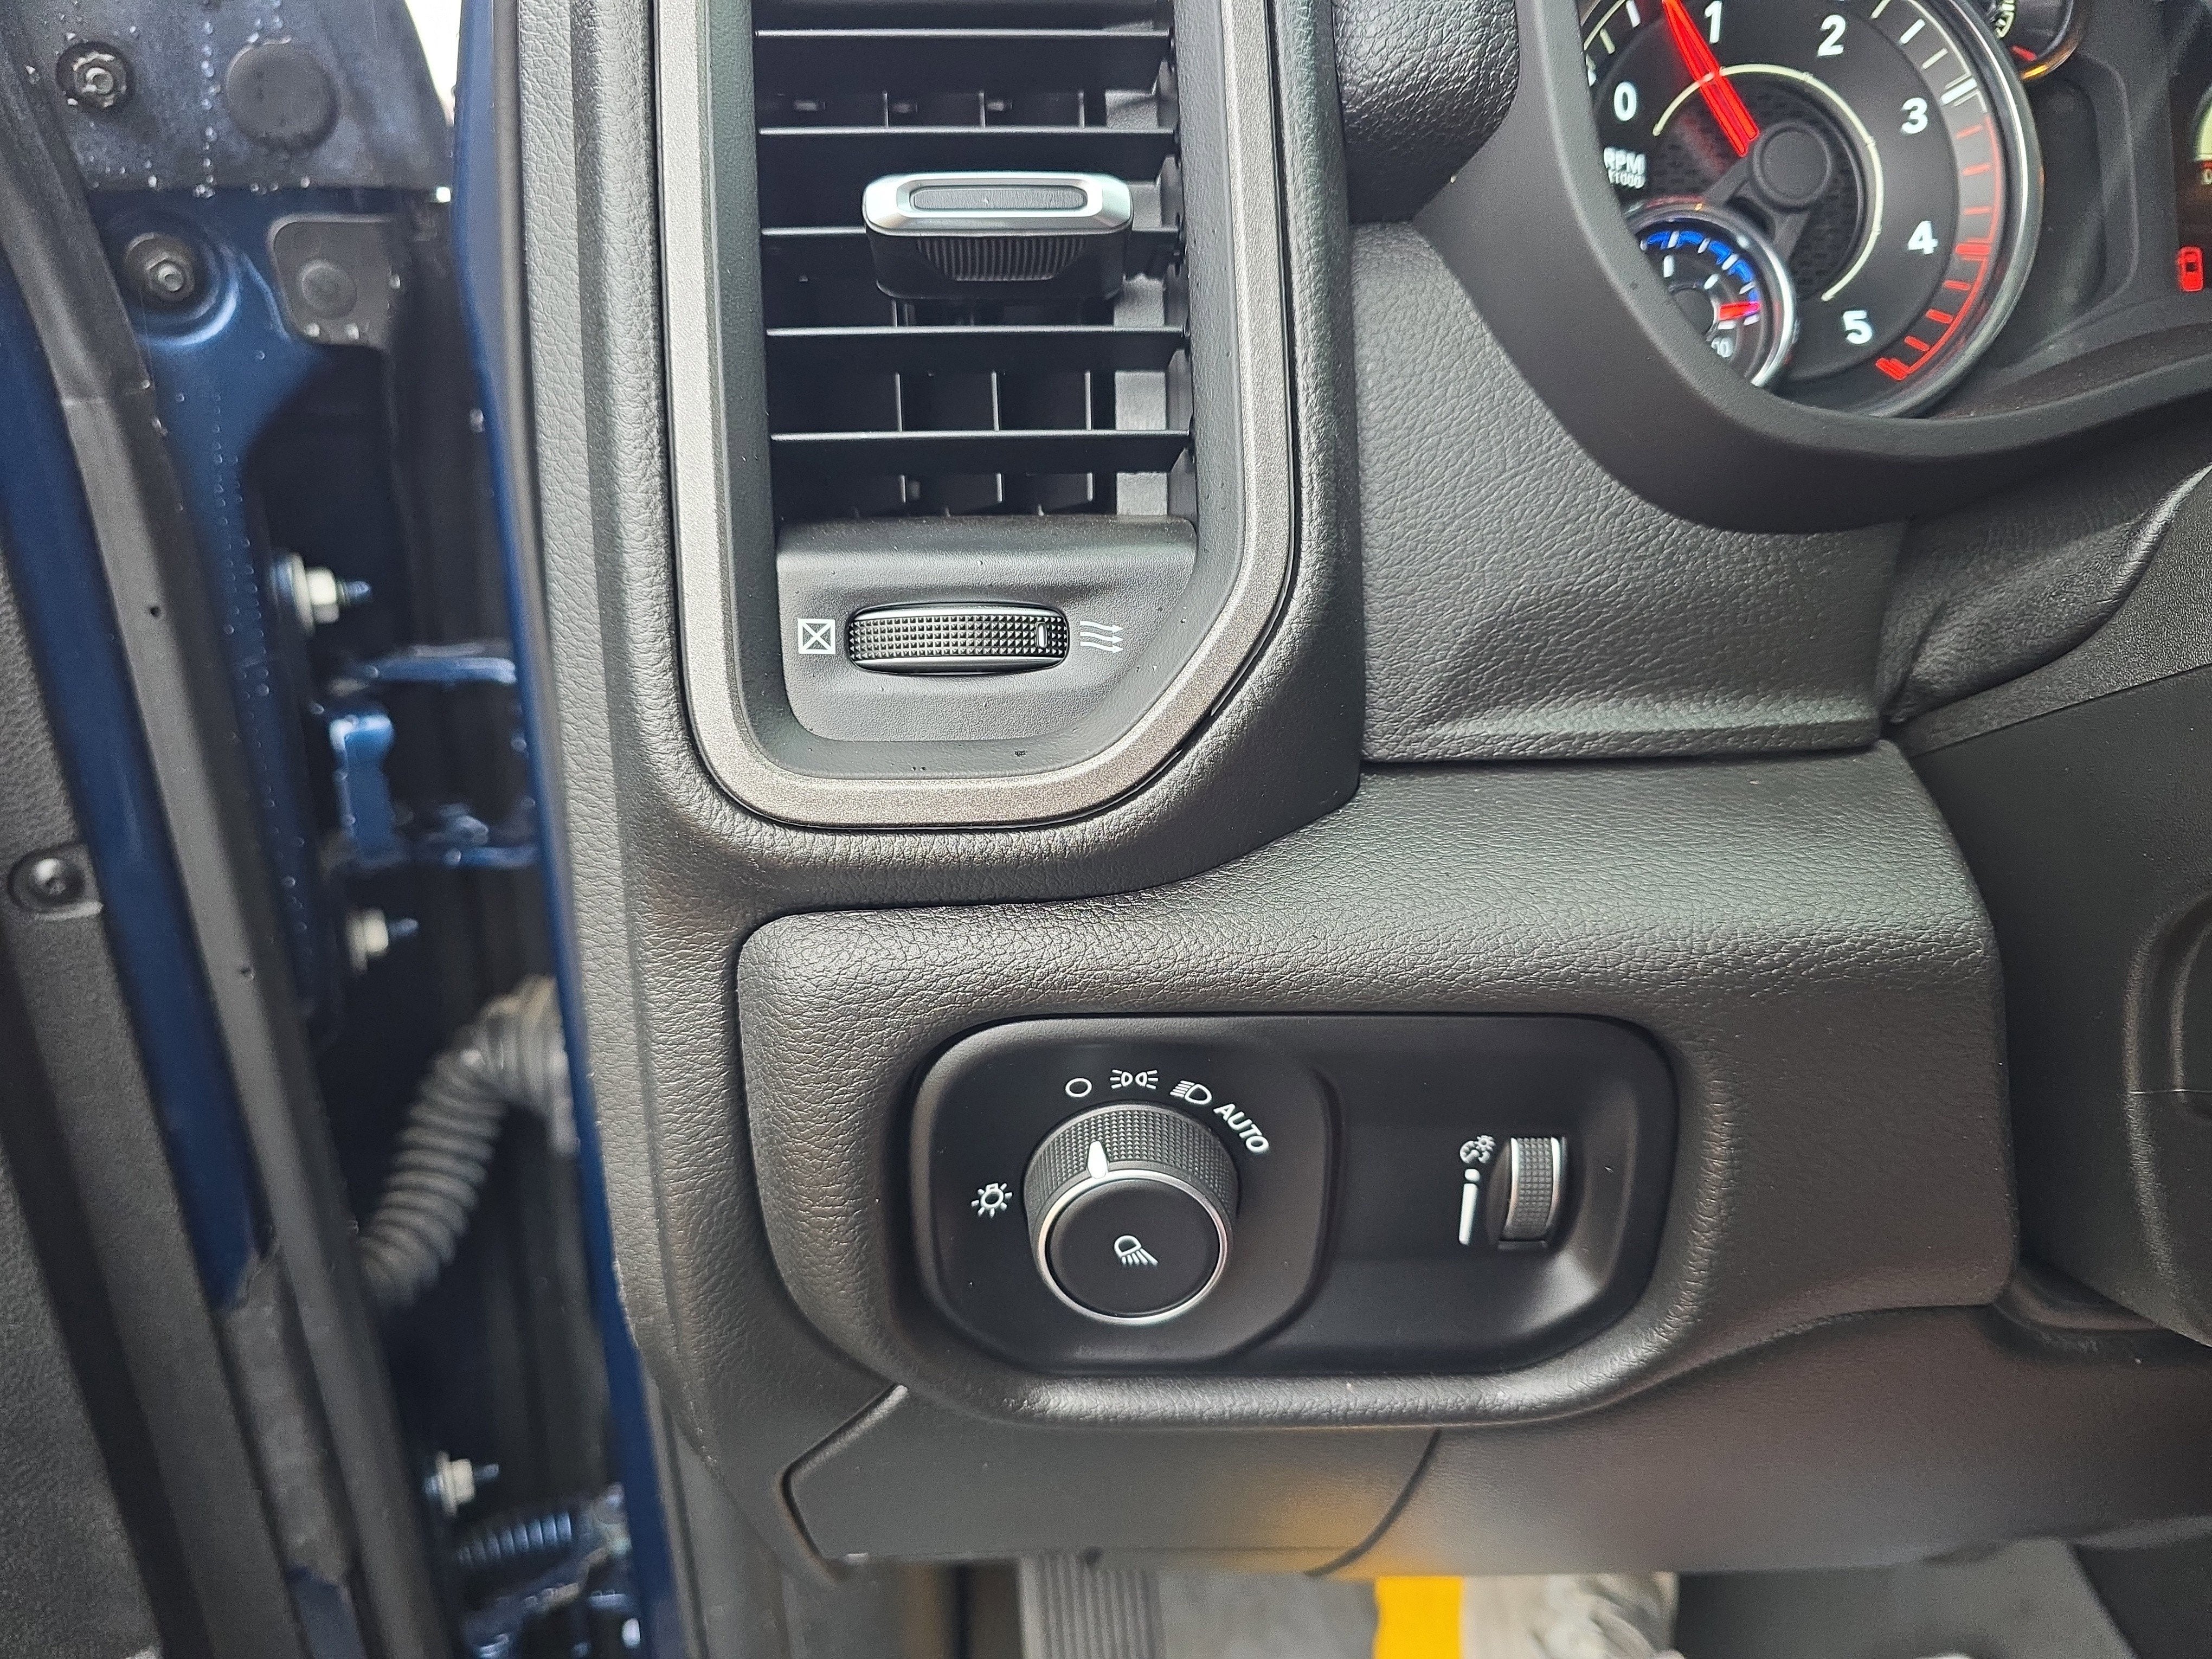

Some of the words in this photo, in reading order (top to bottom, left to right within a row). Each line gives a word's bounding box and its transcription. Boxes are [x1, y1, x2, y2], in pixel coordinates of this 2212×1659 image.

[1705, 0, 1722, 43] 1
[1817, 15, 1846, 57] 2
[1614, 81, 1637, 121] 0
[1901, 97, 1928, 134] 3
[1604, 146, 1646, 174] RPM
[1908, 220, 1938, 255] 4
[1843, 310, 1873, 345] 5
[1213, 1103, 1270, 1153] AUTO
